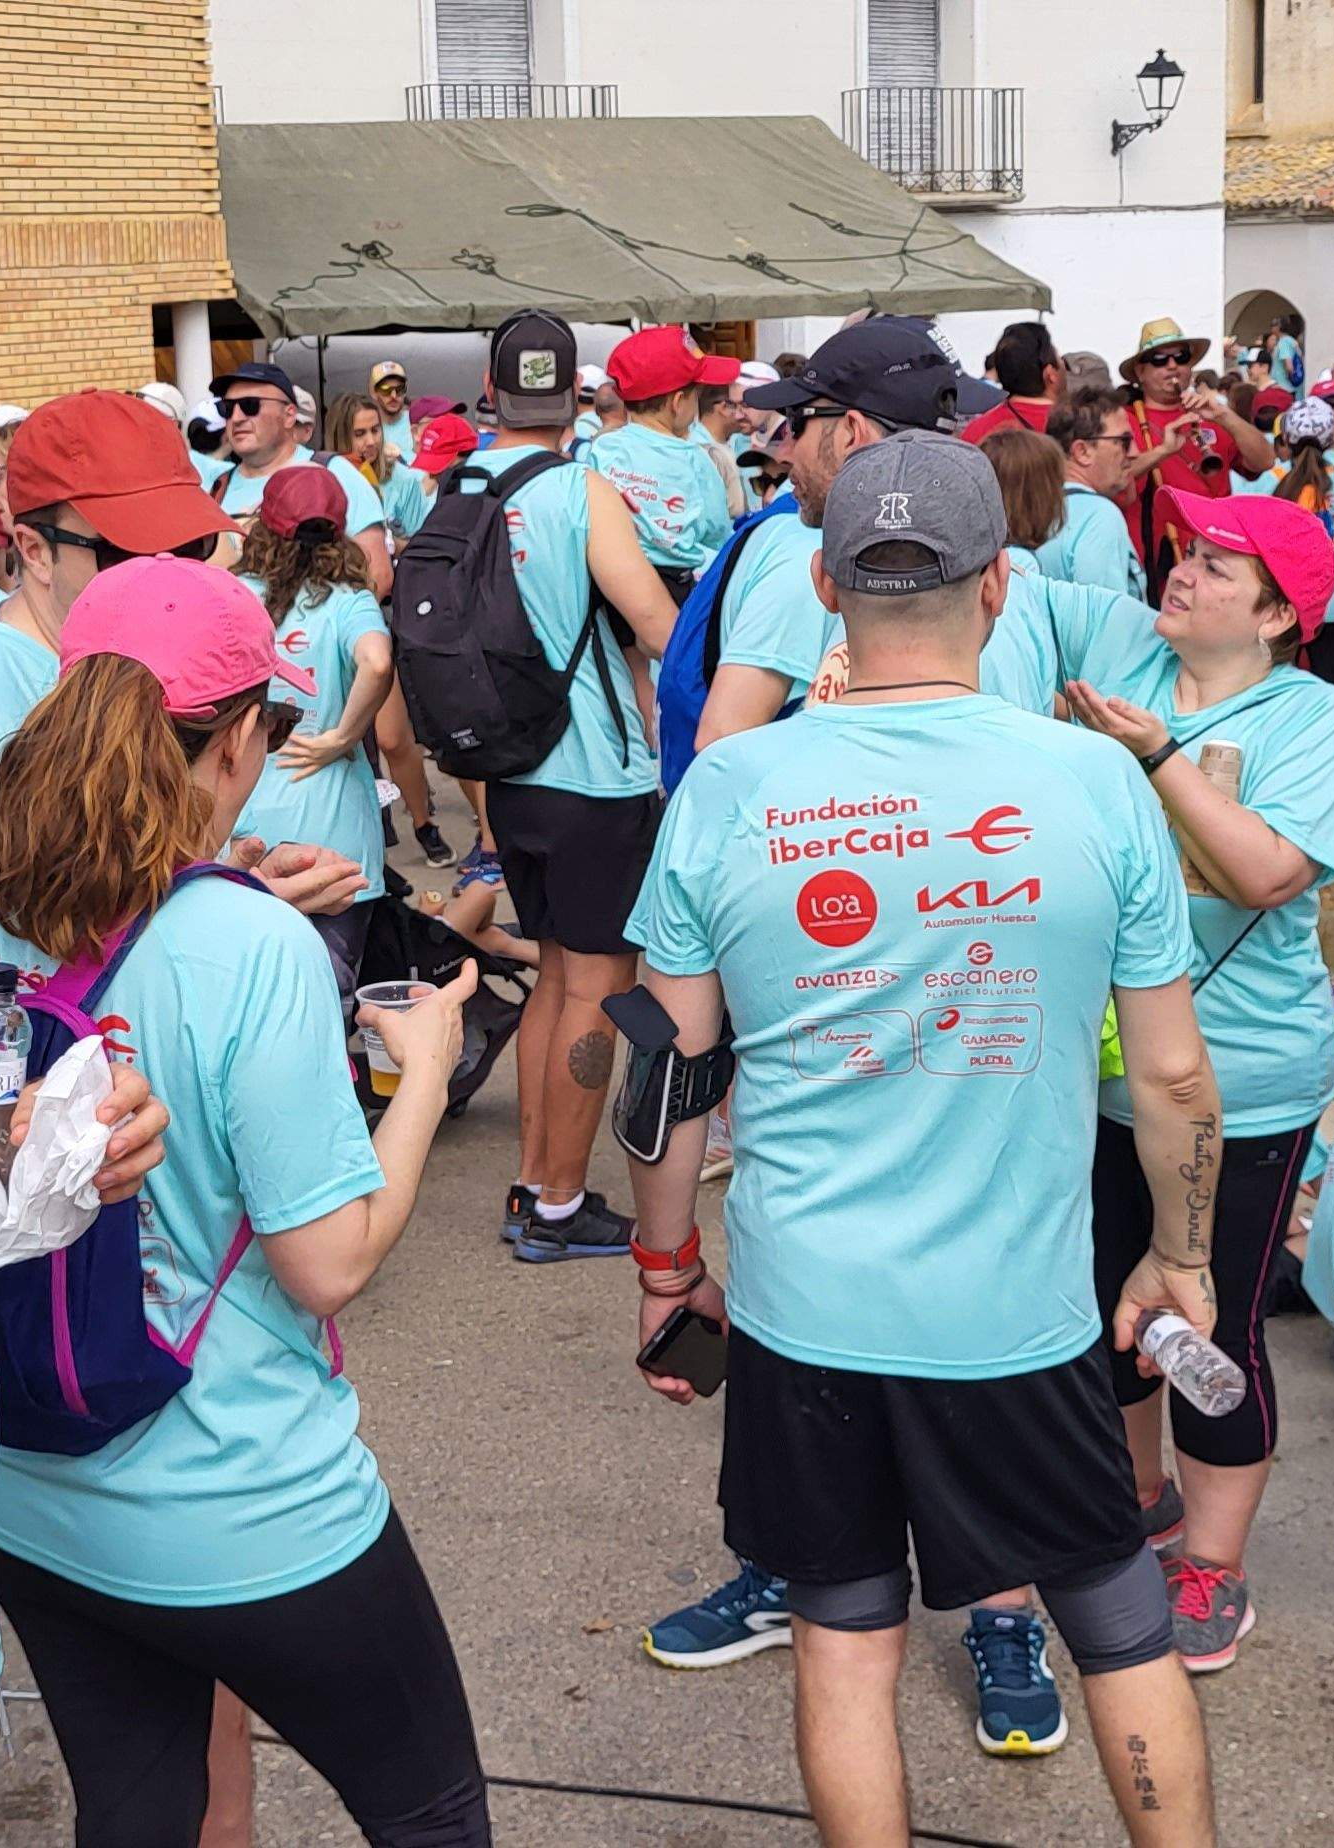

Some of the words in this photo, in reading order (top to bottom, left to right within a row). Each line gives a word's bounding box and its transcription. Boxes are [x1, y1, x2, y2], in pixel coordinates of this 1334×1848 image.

[867, 579, 917, 590] AUSTRIA
[765, 793, 919, 830] Fundación
[768, 823, 930, 865] iberCaja
[924, 914, 988, 930] Automotor
[991, 913, 1037, 925] Huesca
[795, 968, 876, 990] avanza
[924, 967, 1038, 988] escanero
